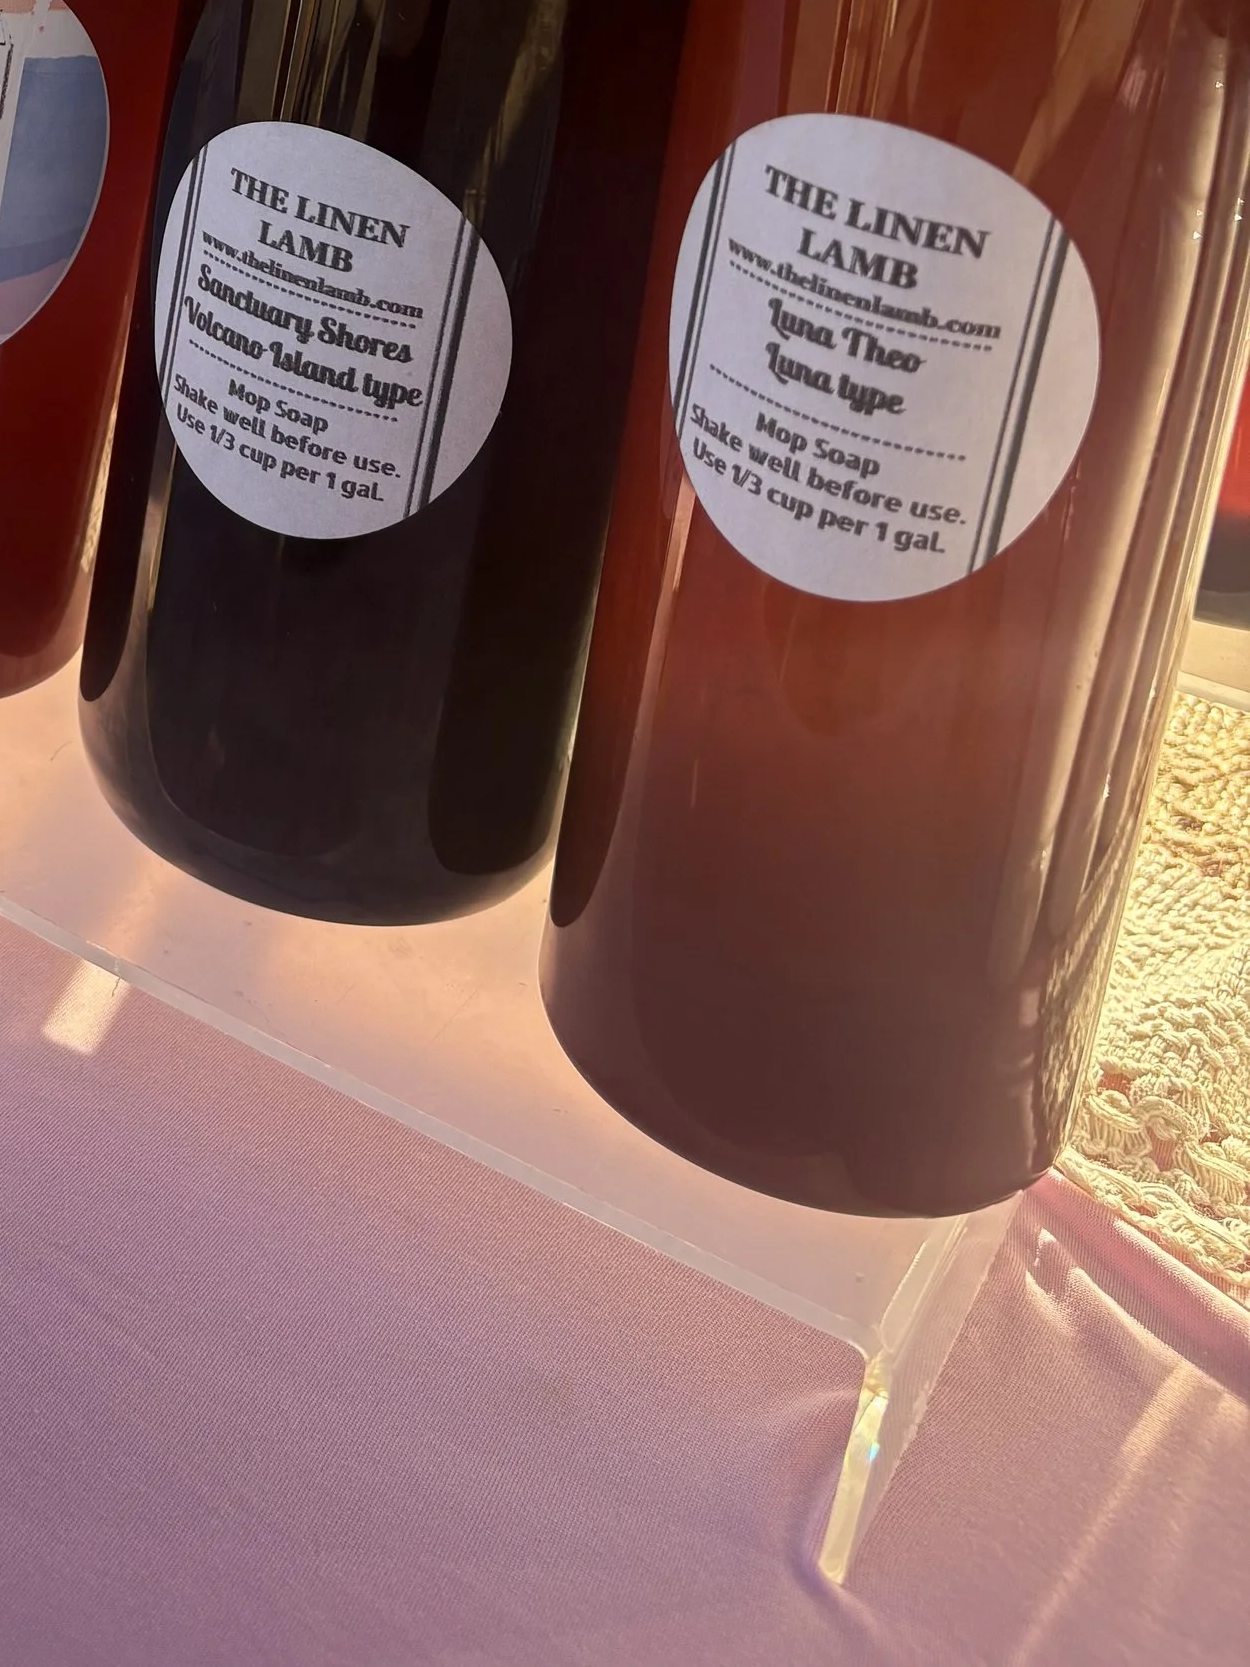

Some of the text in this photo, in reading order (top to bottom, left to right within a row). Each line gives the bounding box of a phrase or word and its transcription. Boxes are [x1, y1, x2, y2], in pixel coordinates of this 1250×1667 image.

[231, 167, 411, 248] THE LINEN
[257, 219, 354, 273] LAMB
[764, 165, 993, 259] THE LINEN
[202, 230, 424, 319] www.thelinenlamb.com
[728, 238, 1002, 339] www.thelinenlamb.com
[796, 228, 918, 291] LAMB
[184, 296, 424, 410] Volcano Island type
[197, 263, 414, 364] Sanctuary Shores
[768, 297, 928, 374] Luna Theo
[228, 378, 329, 436] Mop Soap
[765, 341, 907, 416] Luna type
[174, 372, 402, 479] Shake well before use.
[176, 402, 206, 435] Use
[209, 424, 236, 452] 1/3
[238, 443, 277, 472] cup
[280, 460, 322, 485] per
[325, 471, 338, 490] 1
[690, 403, 968, 525] Shake well before use.
[754, 412, 881, 479] Mop Soap
[692, 437, 728, 476] Use
[731, 463, 764, 496] 1/3
[766, 487, 815, 522] cup
[817, 508, 869, 536] per
[874, 521, 890, 542] 1
